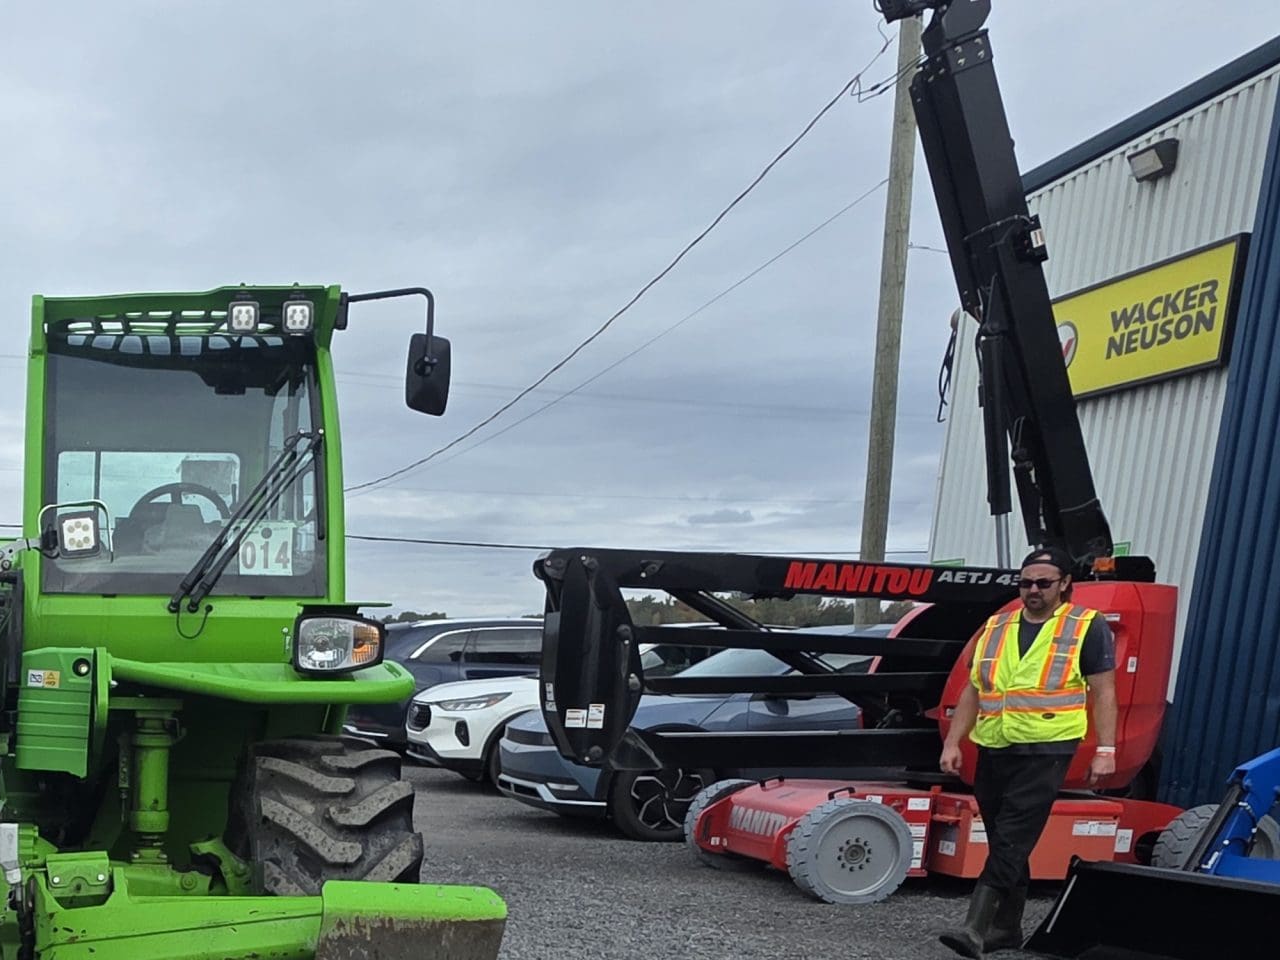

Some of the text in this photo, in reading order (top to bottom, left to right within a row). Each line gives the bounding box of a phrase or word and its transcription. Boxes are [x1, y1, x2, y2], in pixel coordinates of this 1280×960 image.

[1111, 279, 1219, 333] WACKER
[1105, 306, 1217, 360] NEUSON
[241, 541, 290, 569] 014
[784, 562, 933, 595] MANITOU
[937, 570, 992, 584] AETJ
